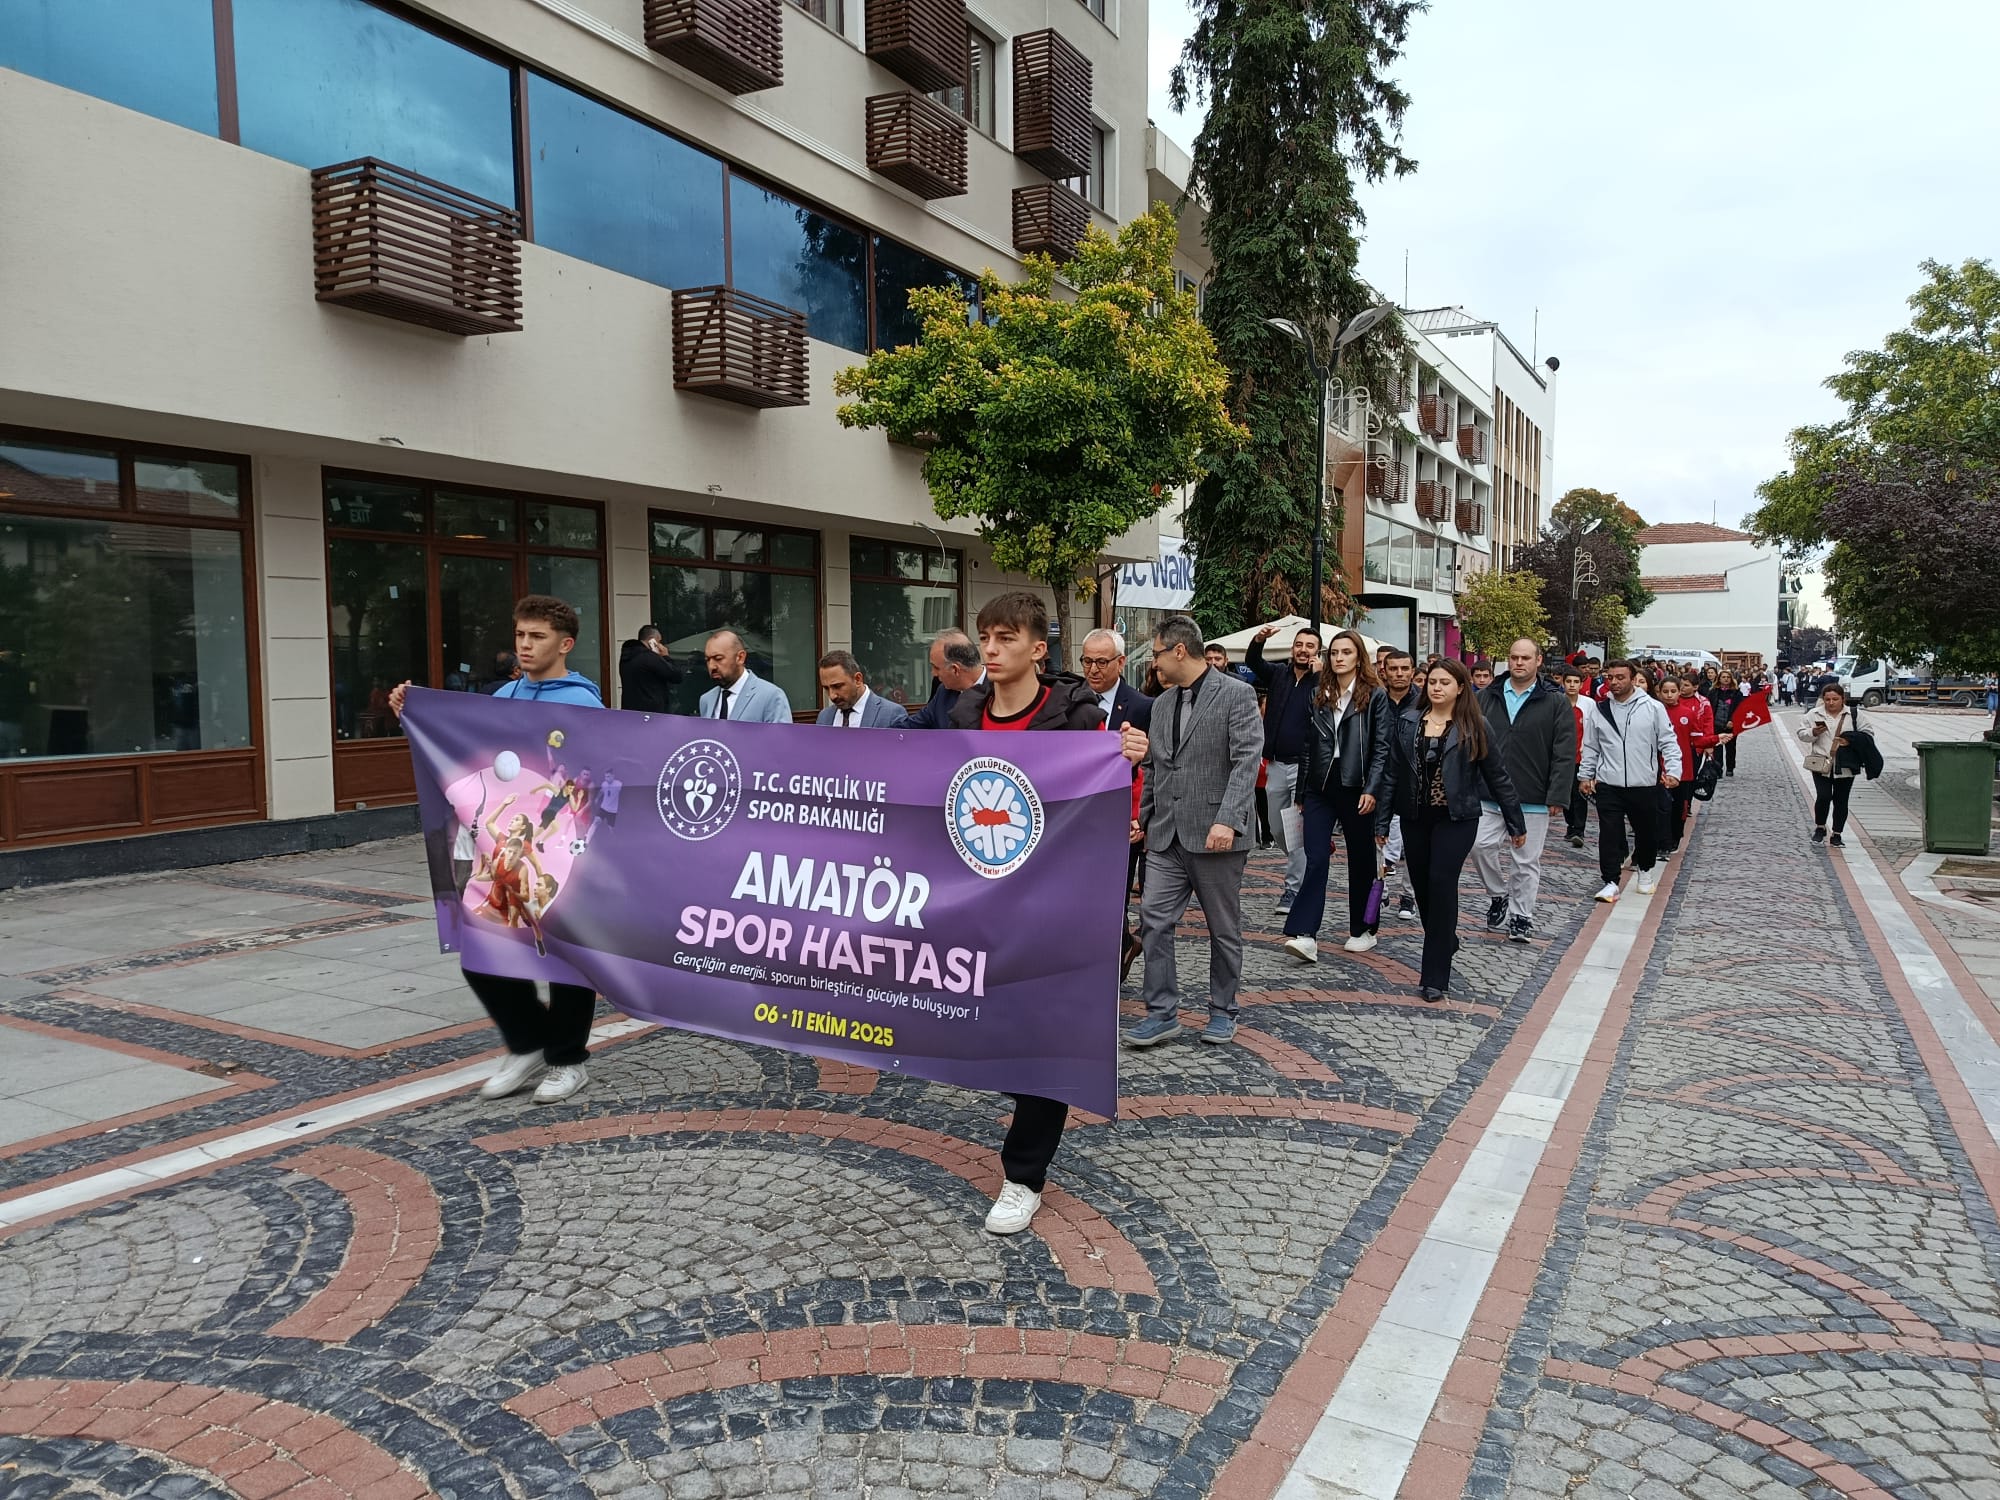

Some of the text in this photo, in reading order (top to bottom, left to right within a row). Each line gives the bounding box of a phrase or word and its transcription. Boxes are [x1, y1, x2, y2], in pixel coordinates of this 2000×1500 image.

[747, 799, 885, 834] SPOR BAKANLIĞI
[752, 771, 887, 803] T.C. GENÇLİK VE
[947, 781, 960, 818] AMATÖR
[957, 764, 973, 783] SPOR
[973, 758, 1016, 777] KULÜPLERİ
[1014, 773, 1042, 857] KONFEDERASYONU
[730, 850, 930, 930] AMATÖR
[673, 951, 980, 1021] Gençliğin enerjisi, sporun birleştirici gücüyle buluşuyor !
[675, 905, 987, 997] SPOR HAFTASI
[754, 1003, 779, 1024] 06
[790, 1009, 803, 1029] 11
[806, 1010, 847, 1037] EKİM
[850, 1020, 894, 1047] 2025
